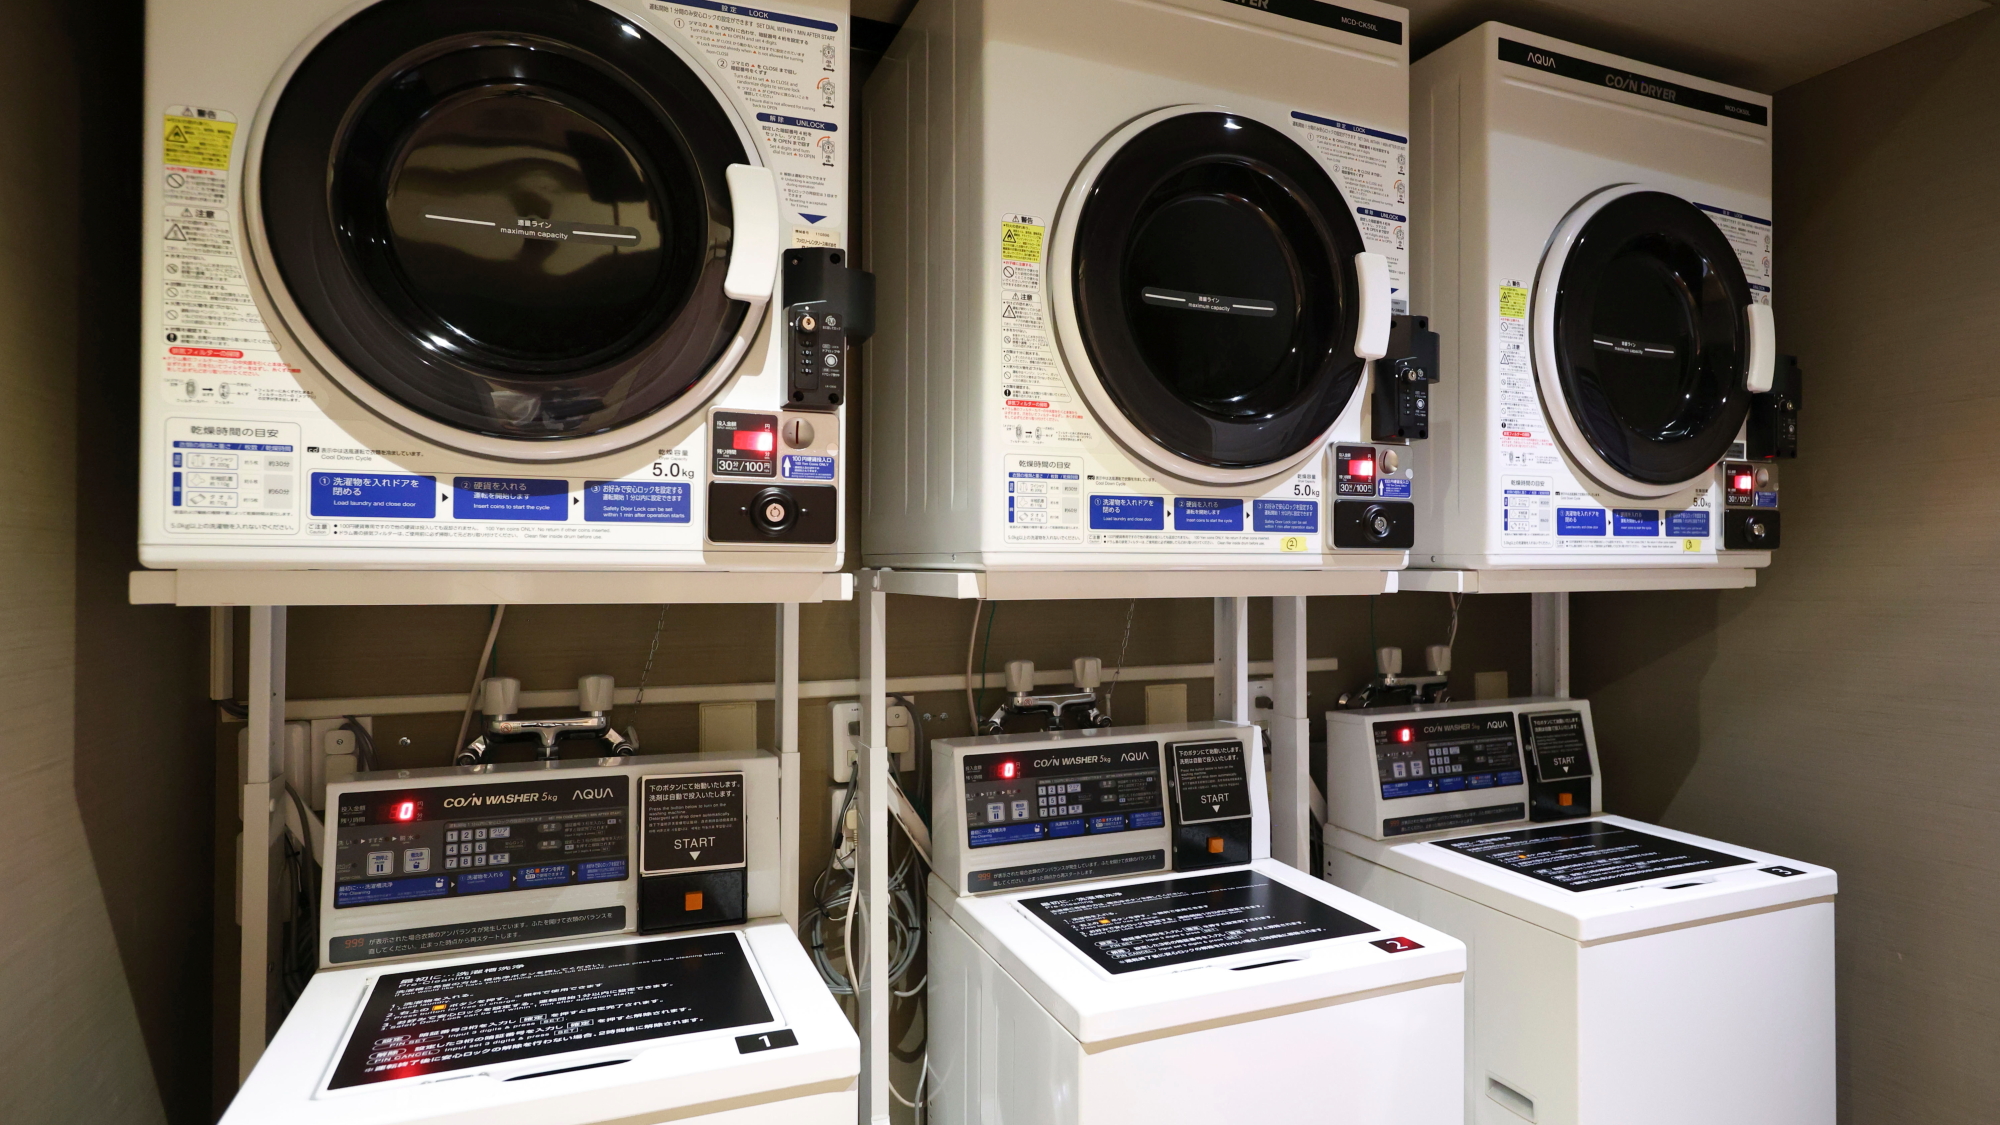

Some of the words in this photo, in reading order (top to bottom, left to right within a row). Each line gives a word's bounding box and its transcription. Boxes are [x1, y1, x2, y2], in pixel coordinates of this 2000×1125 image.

[748, 9, 769, 19] LOCK
[1341, 16, 1378, 32] MCD-CK50L
[776, 26, 792, 34] WITHIN
[806, 31, 820, 39] AFTER
[1527, 52, 1556, 69] AQUA
[1605, 73, 1638, 92] COIN
[1640, 81, 1677, 101] DRYER
[796, 119, 825, 130] UNLOCK
[1021, 216, 1033, 225] 警告
[500, 227, 536, 237] maximum
[537, 231, 568, 240] capacity
[1188, 302, 1210, 310] maximum
[190, 425, 279, 438] 乾燥時間の目安
[652, 462, 680, 477] 5.0
[682, 468, 695, 479] kg
[1018, 460, 1071, 469] 乾燥時間の目安
[332, 477, 419, 488] 洗濯物を入れドアを
[473, 481, 527, 492] 硬貨を入れる
[332, 487, 362, 496] 閉める
[1294, 484, 1311, 497] 5.0
[1312, 489, 1320, 497] kg
[1102, 499, 1154, 507] 洗濯物を入れドアを
[1693, 497, 1705, 507] 5.0
[1424, 723, 1443, 734] COIN
[1443, 724, 1471, 732] WASHER
[1487, 721, 1508, 729] AQUA
[1034, 755, 1060, 768] COIN
[1062, 755, 1098, 765] WASHER
[1121, 751, 1149, 762] AQUA
[1553, 756, 1575, 766] START
[1004, 762, 1015, 777] 0
[443, 793, 484, 808] COIN
[486, 792, 540, 806] WASHER
[572, 788, 614, 800] AQUA
[1201, 793, 1229, 804] START
[400, 802, 414, 820] 0
[674, 836, 716, 850] START
[977, 873, 991, 881] 999
[344, 938, 365, 949] 999
[1386, 940, 1408, 950] 2
[397, 974, 472, 988] Pre-Cleaning
[447, 1030, 469, 1038] Input
[479, 1025, 502, 1033] digits
[407, 1037, 428, 1045] SET
[443, 1044, 466, 1053] Input
[492, 1037, 515, 1045] digits
[526, 1032, 550, 1040] press
[758, 1034, 772, 1048] 1
[373, 1056, 392, 1064] PIN
[393, 1049, 434, 1060] CANCEL
